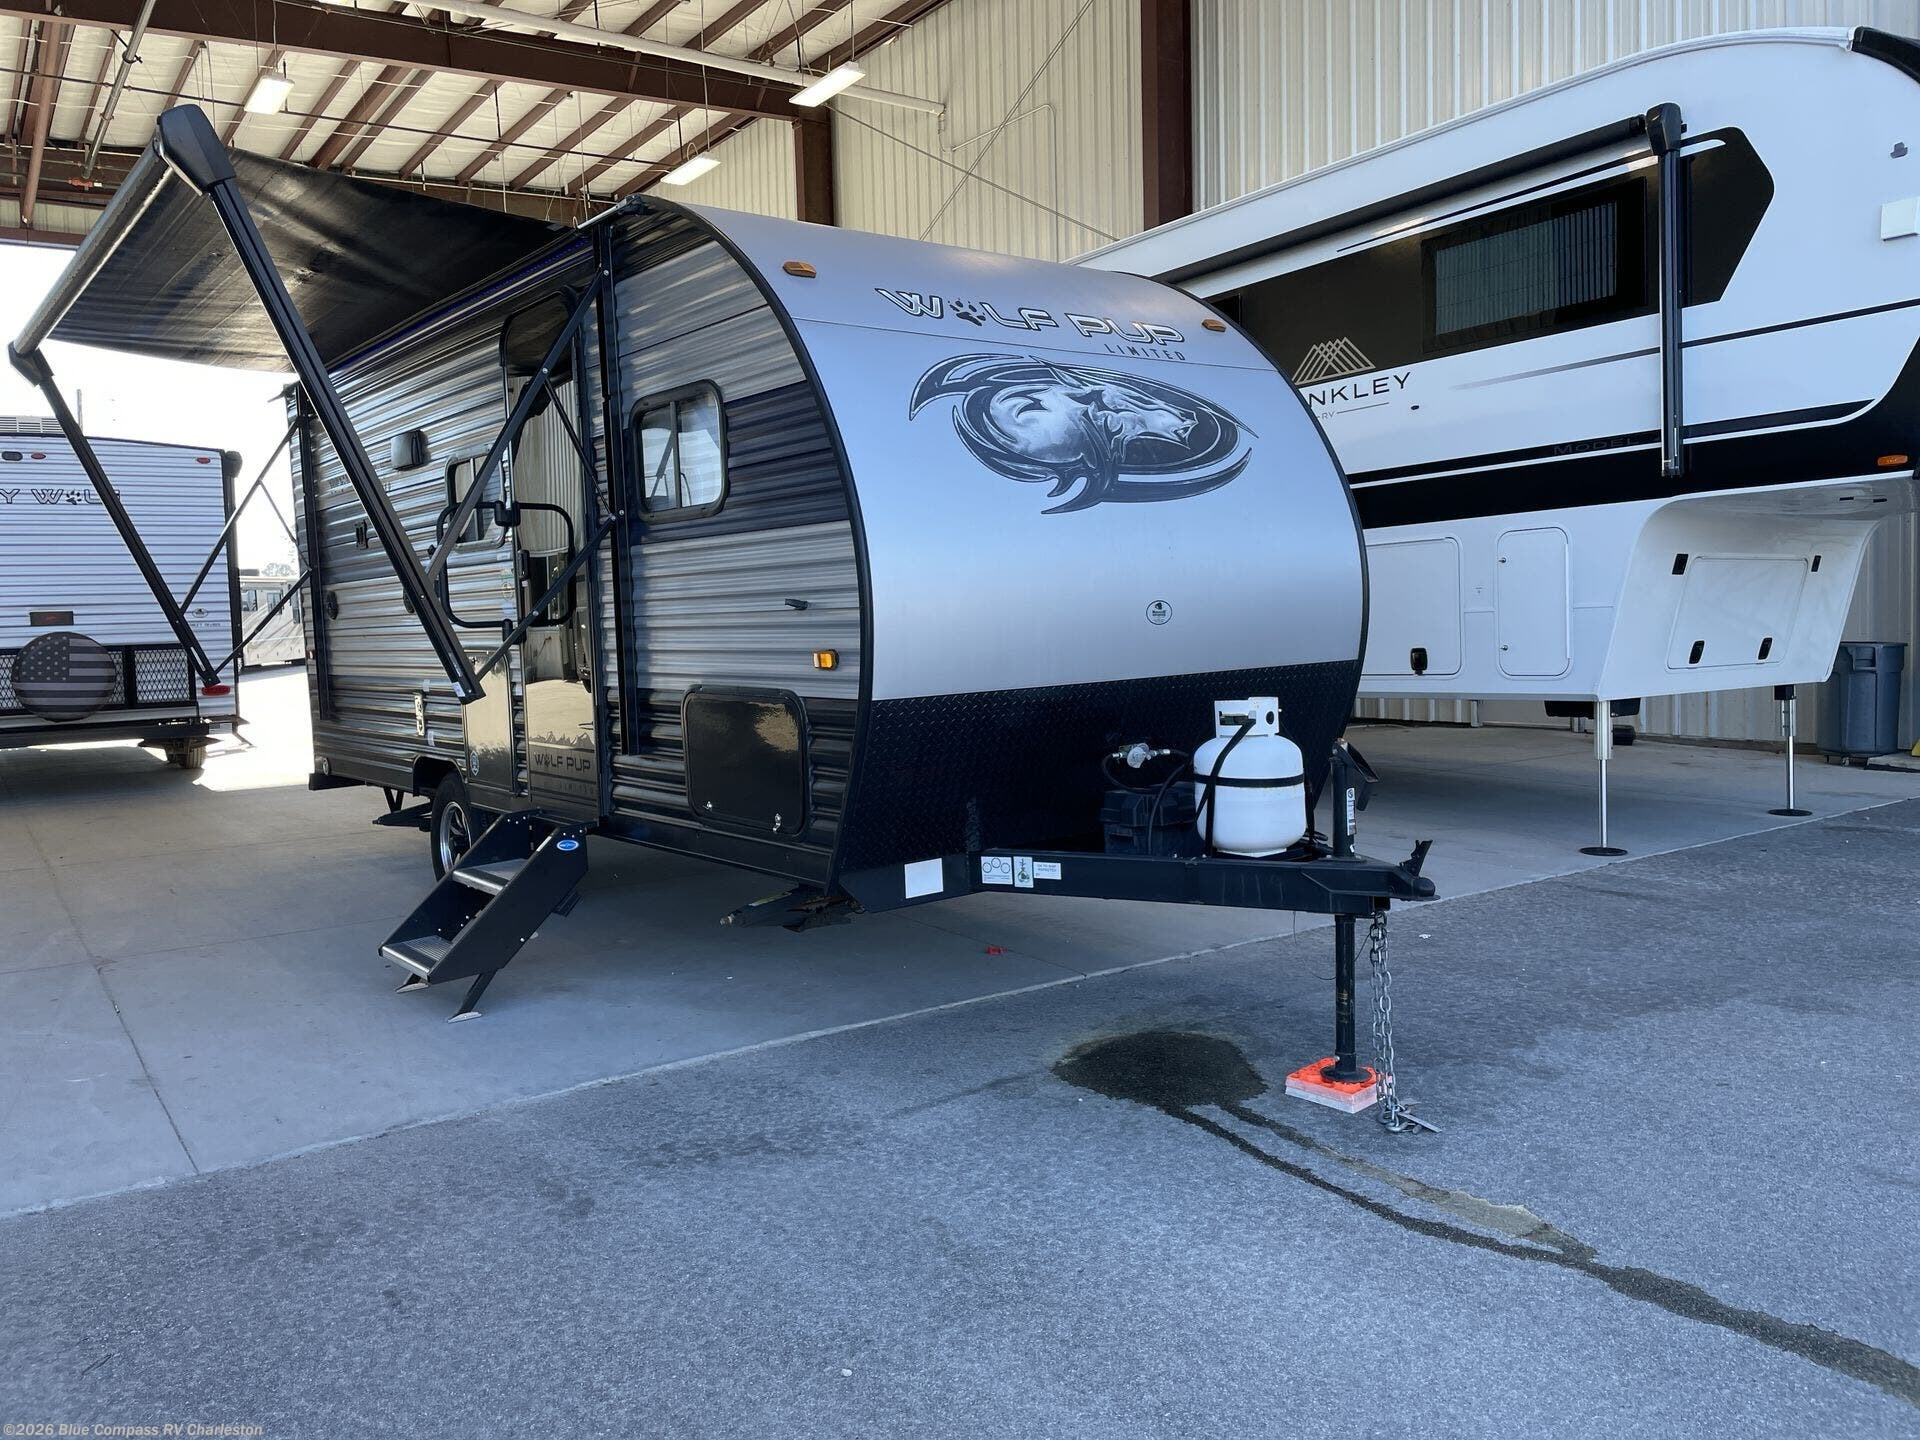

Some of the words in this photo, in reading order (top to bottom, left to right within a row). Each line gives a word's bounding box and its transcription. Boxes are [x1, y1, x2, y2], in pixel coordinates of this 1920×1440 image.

[1064, 313, 1185, 346] PUP
[1103, 343, 1186, 361] LIMITED
[1321, 411, 1336, 421] RV
[566, 756, 591, 774] PUP
